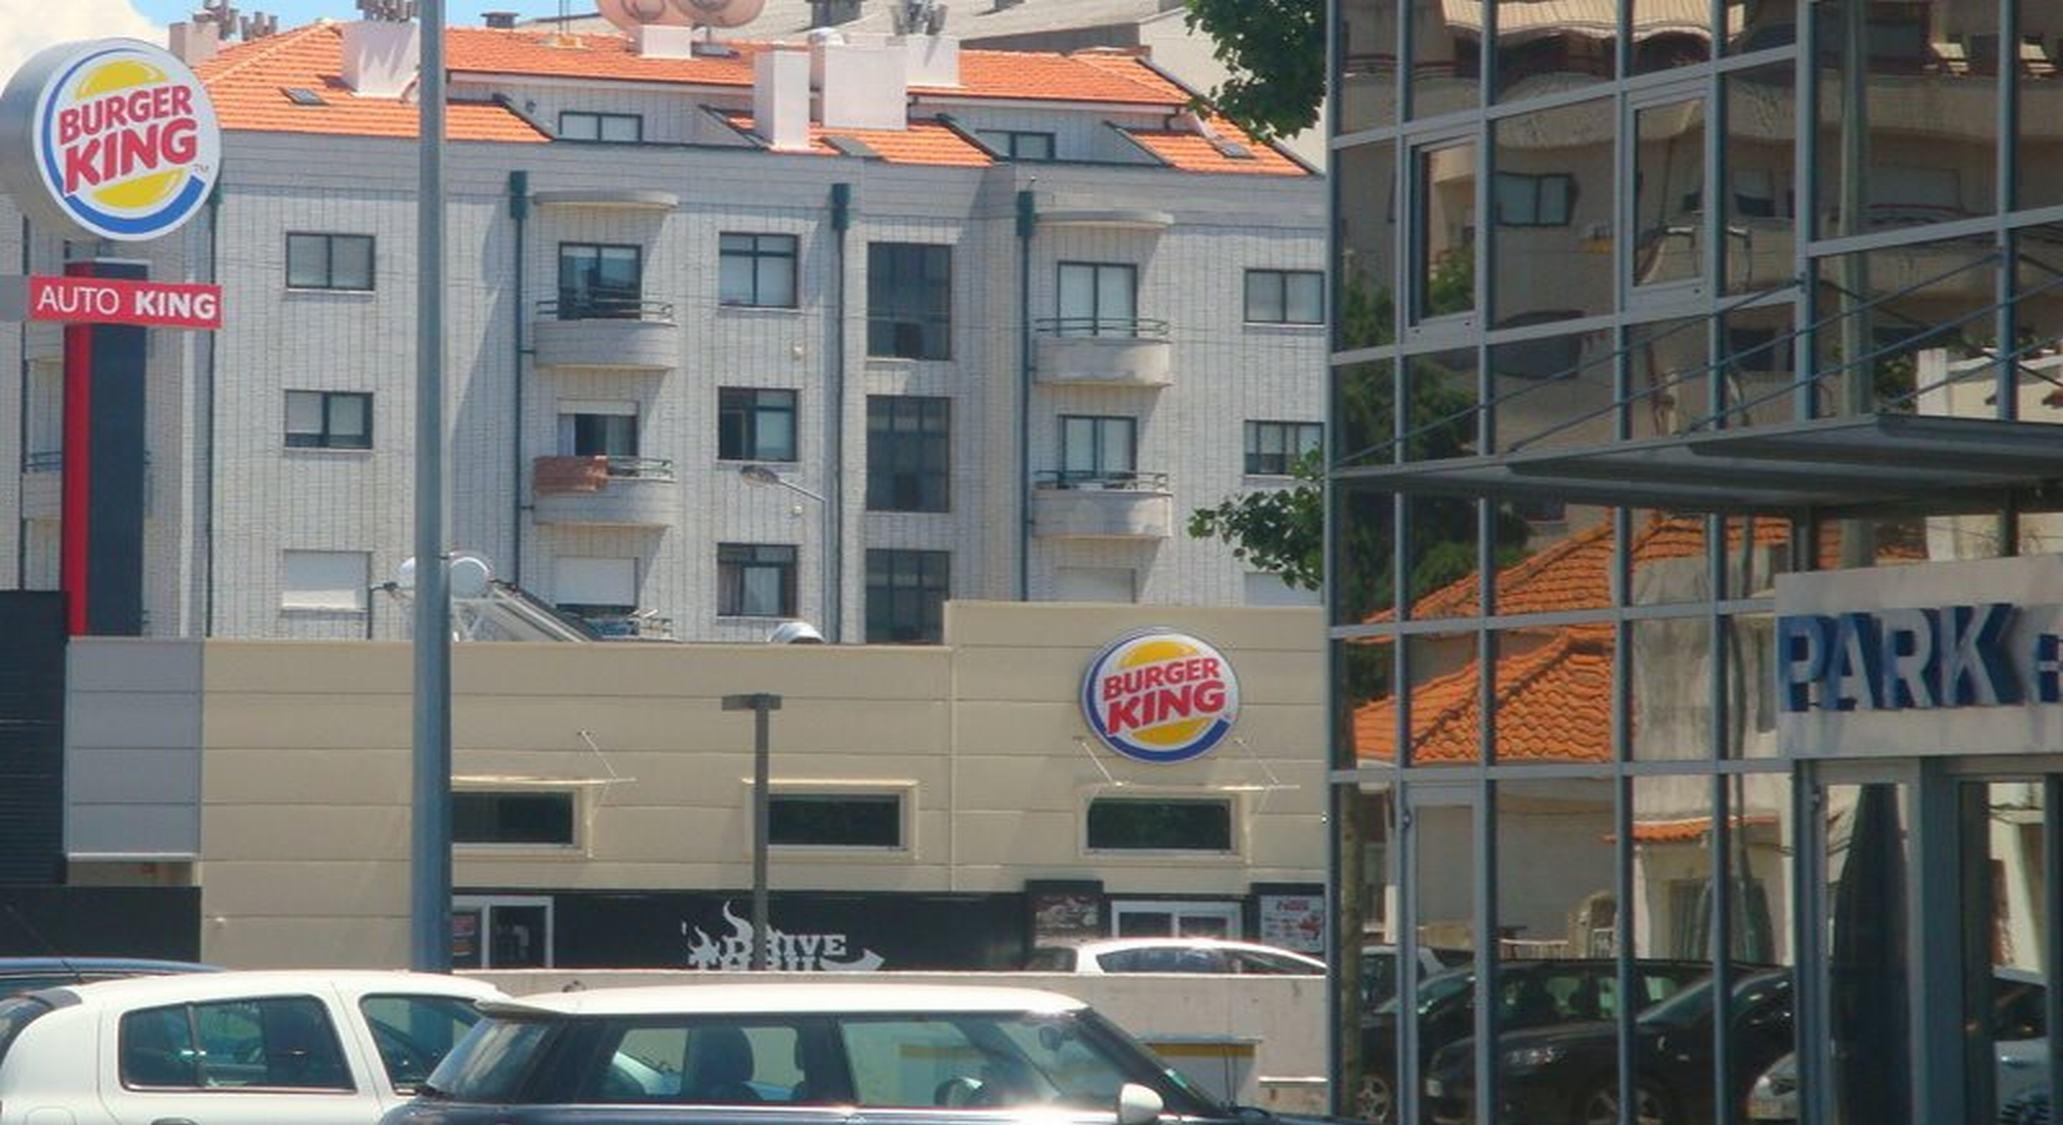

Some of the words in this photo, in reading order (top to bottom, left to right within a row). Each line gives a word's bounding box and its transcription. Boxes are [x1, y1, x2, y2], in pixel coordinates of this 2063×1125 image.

[59, 85, 193, 145] BURGER
[64, 118, 197, 194] KING
[36, 286, 120, 315] AUTO
[134, 290, 217, 320] KING
[1103, 657, 1221, 701] BURGER
[1777, 603, 2022, 712] PARK
[1107, 680, 1226, 736] KING
